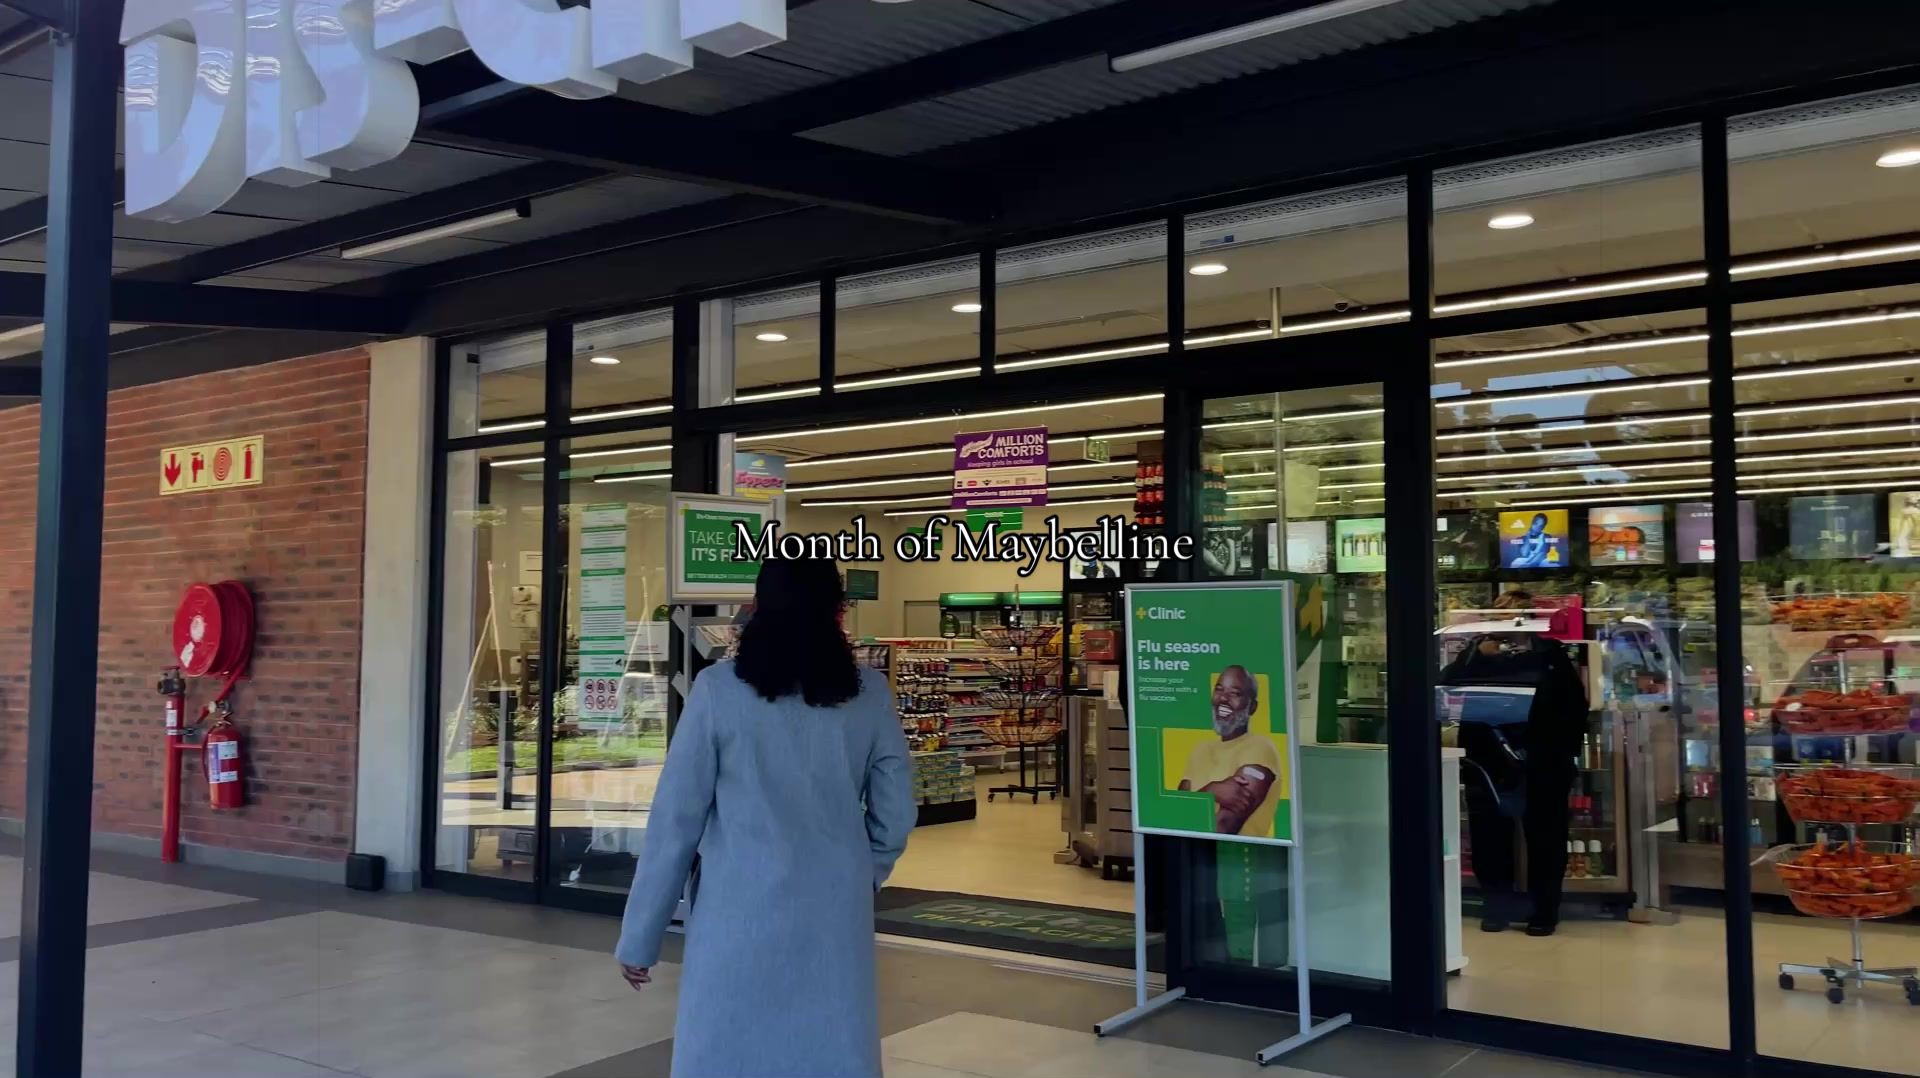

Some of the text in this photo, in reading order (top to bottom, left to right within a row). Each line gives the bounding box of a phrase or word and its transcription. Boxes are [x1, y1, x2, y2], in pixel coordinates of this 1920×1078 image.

[995, 433, 1045, 447] MILLION
[977, 444, 1045, 459] COMFORTS
[688, 530, 725, 545] TAKE
[691, 547, 717, 562] IT'S
[1148, 607, 1187, 620] Clinic
[1137, 640, 1221, 654] Flu season
[1138, 657, 1190, 670] is here
